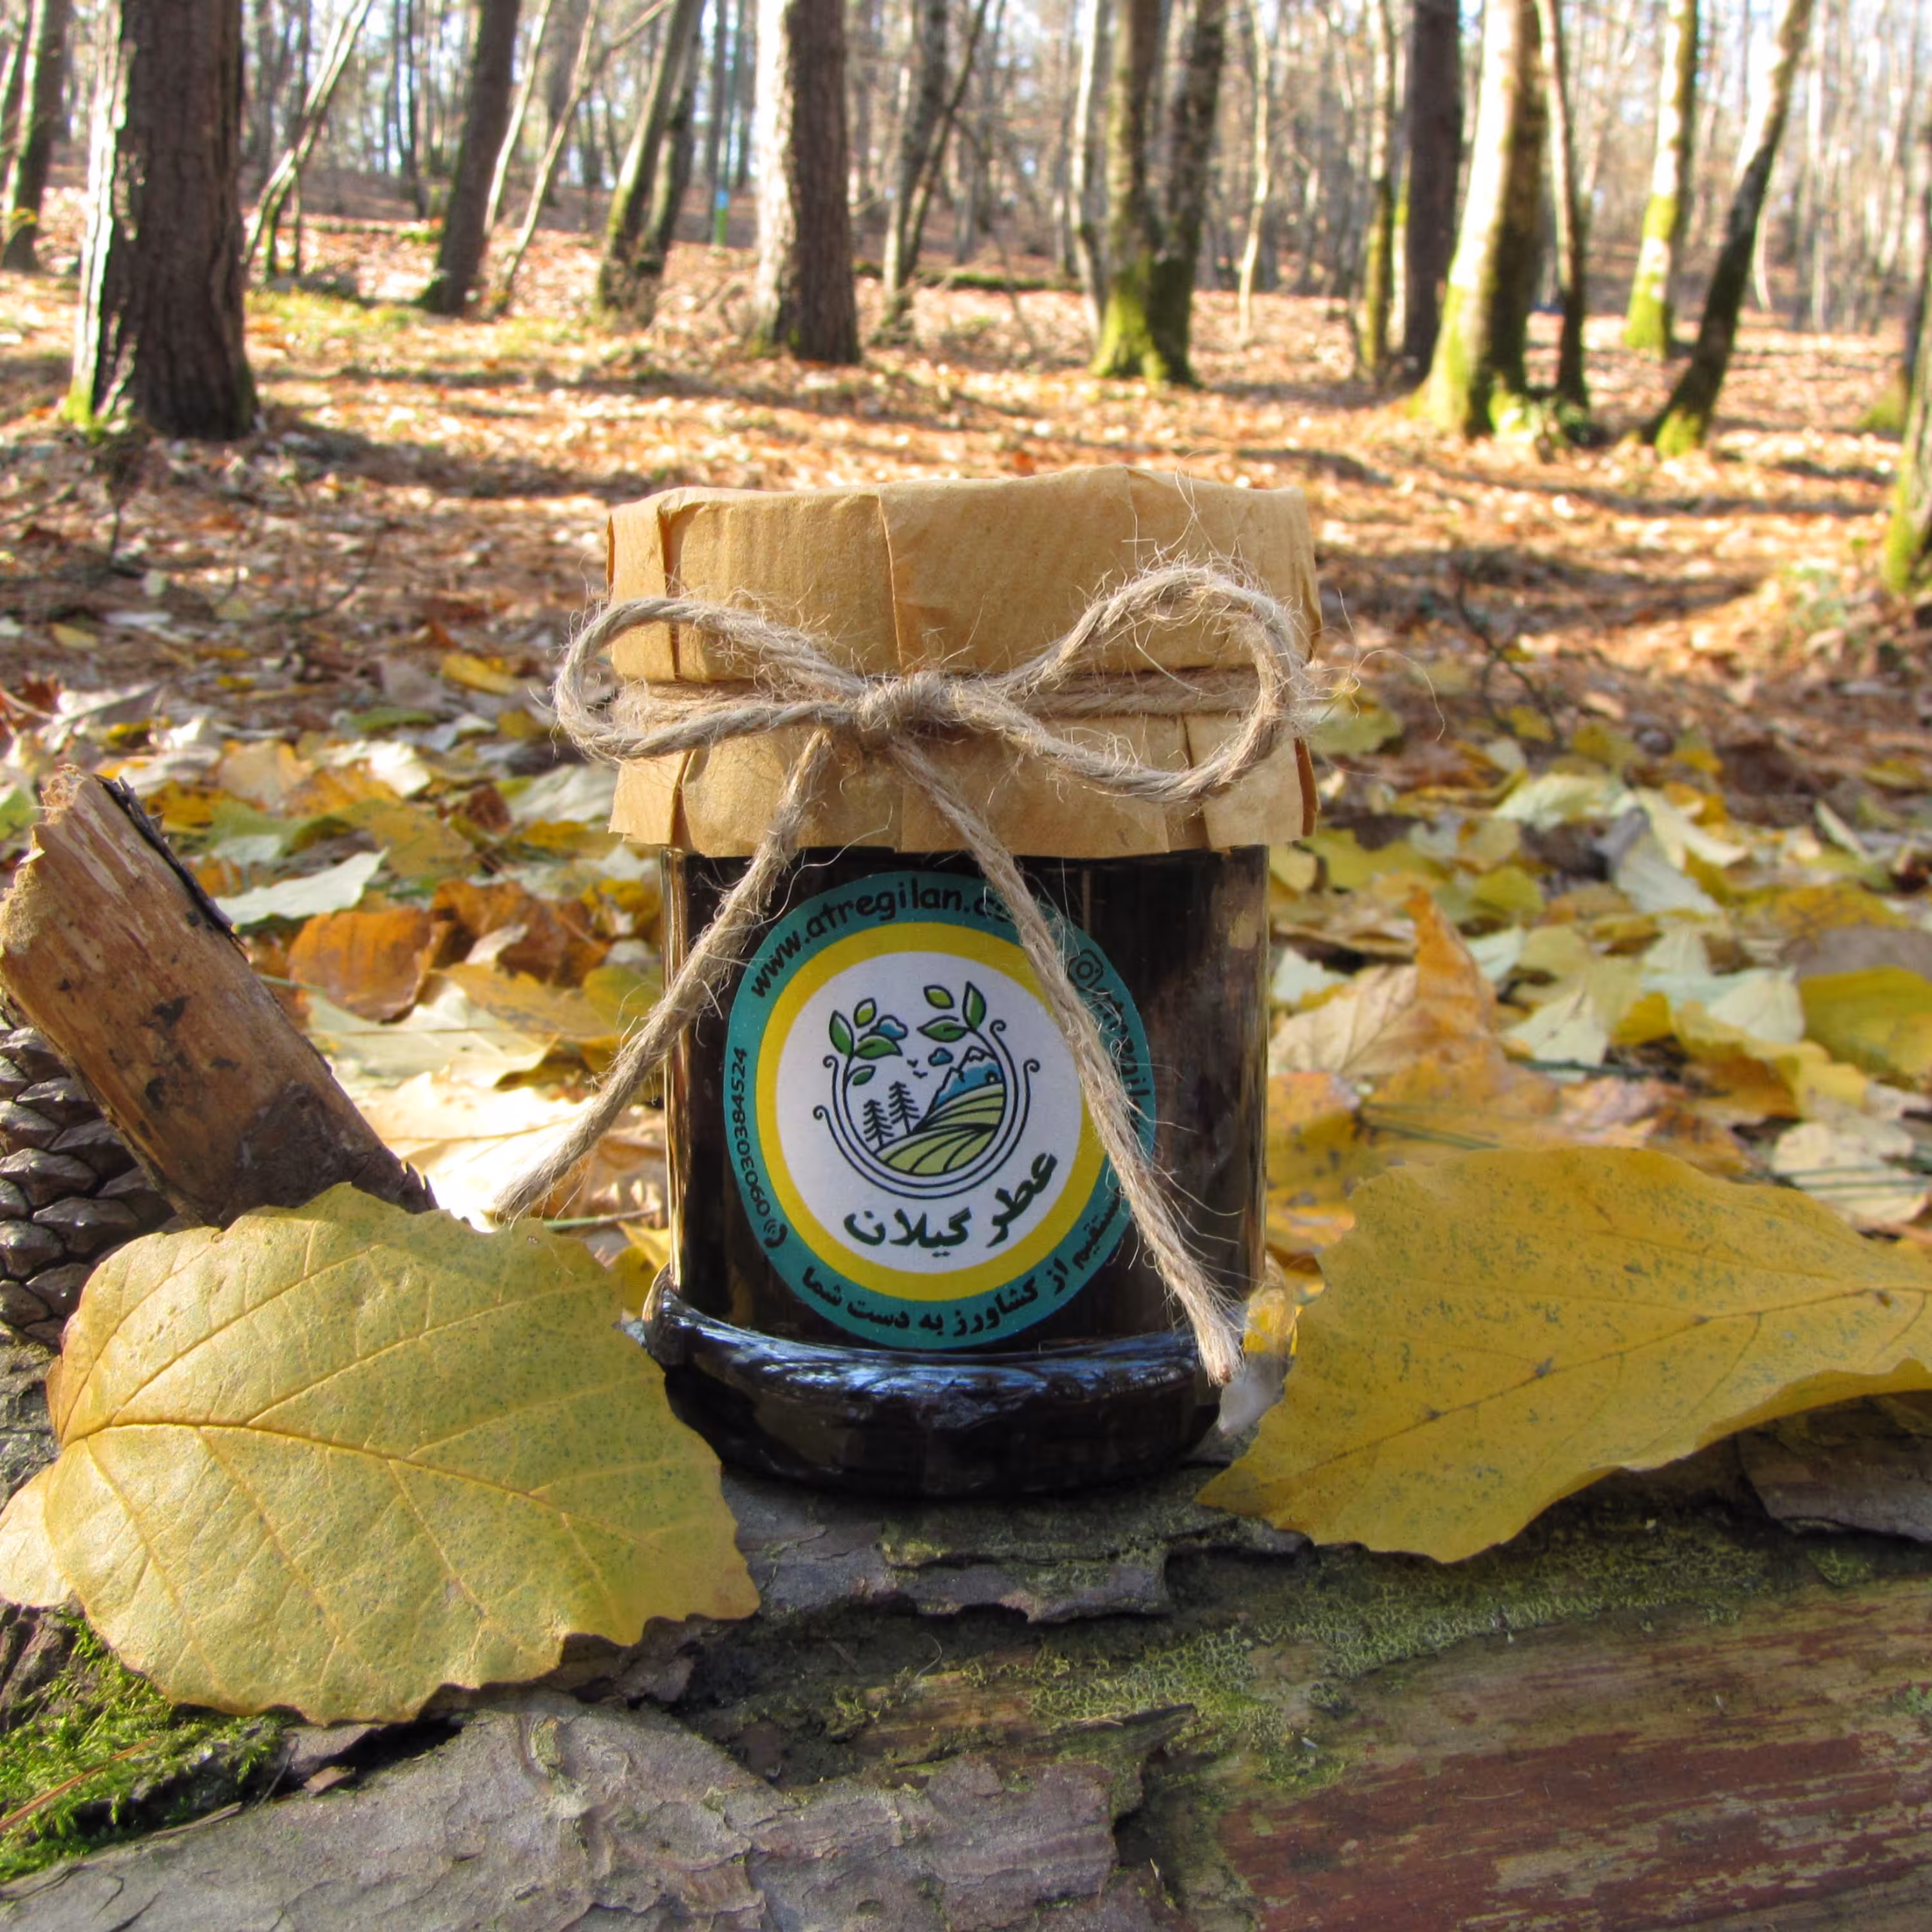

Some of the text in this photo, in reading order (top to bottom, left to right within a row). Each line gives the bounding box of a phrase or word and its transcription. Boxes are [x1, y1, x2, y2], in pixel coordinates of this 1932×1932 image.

[751, 878, 1012, 998] www.atregilan.co
[731, 1046, 771, 1217] 09030384524
[985, 1152, 1057, 1249] عطر
[802, 1266, 843, 1307] شما
[1046, 1257, 1069, 1296] از
[846, 1300, 911, 1330] دست
[918, 1310, 944, 1336] به
[952, 1276, 1039, 1338] کشاورز
